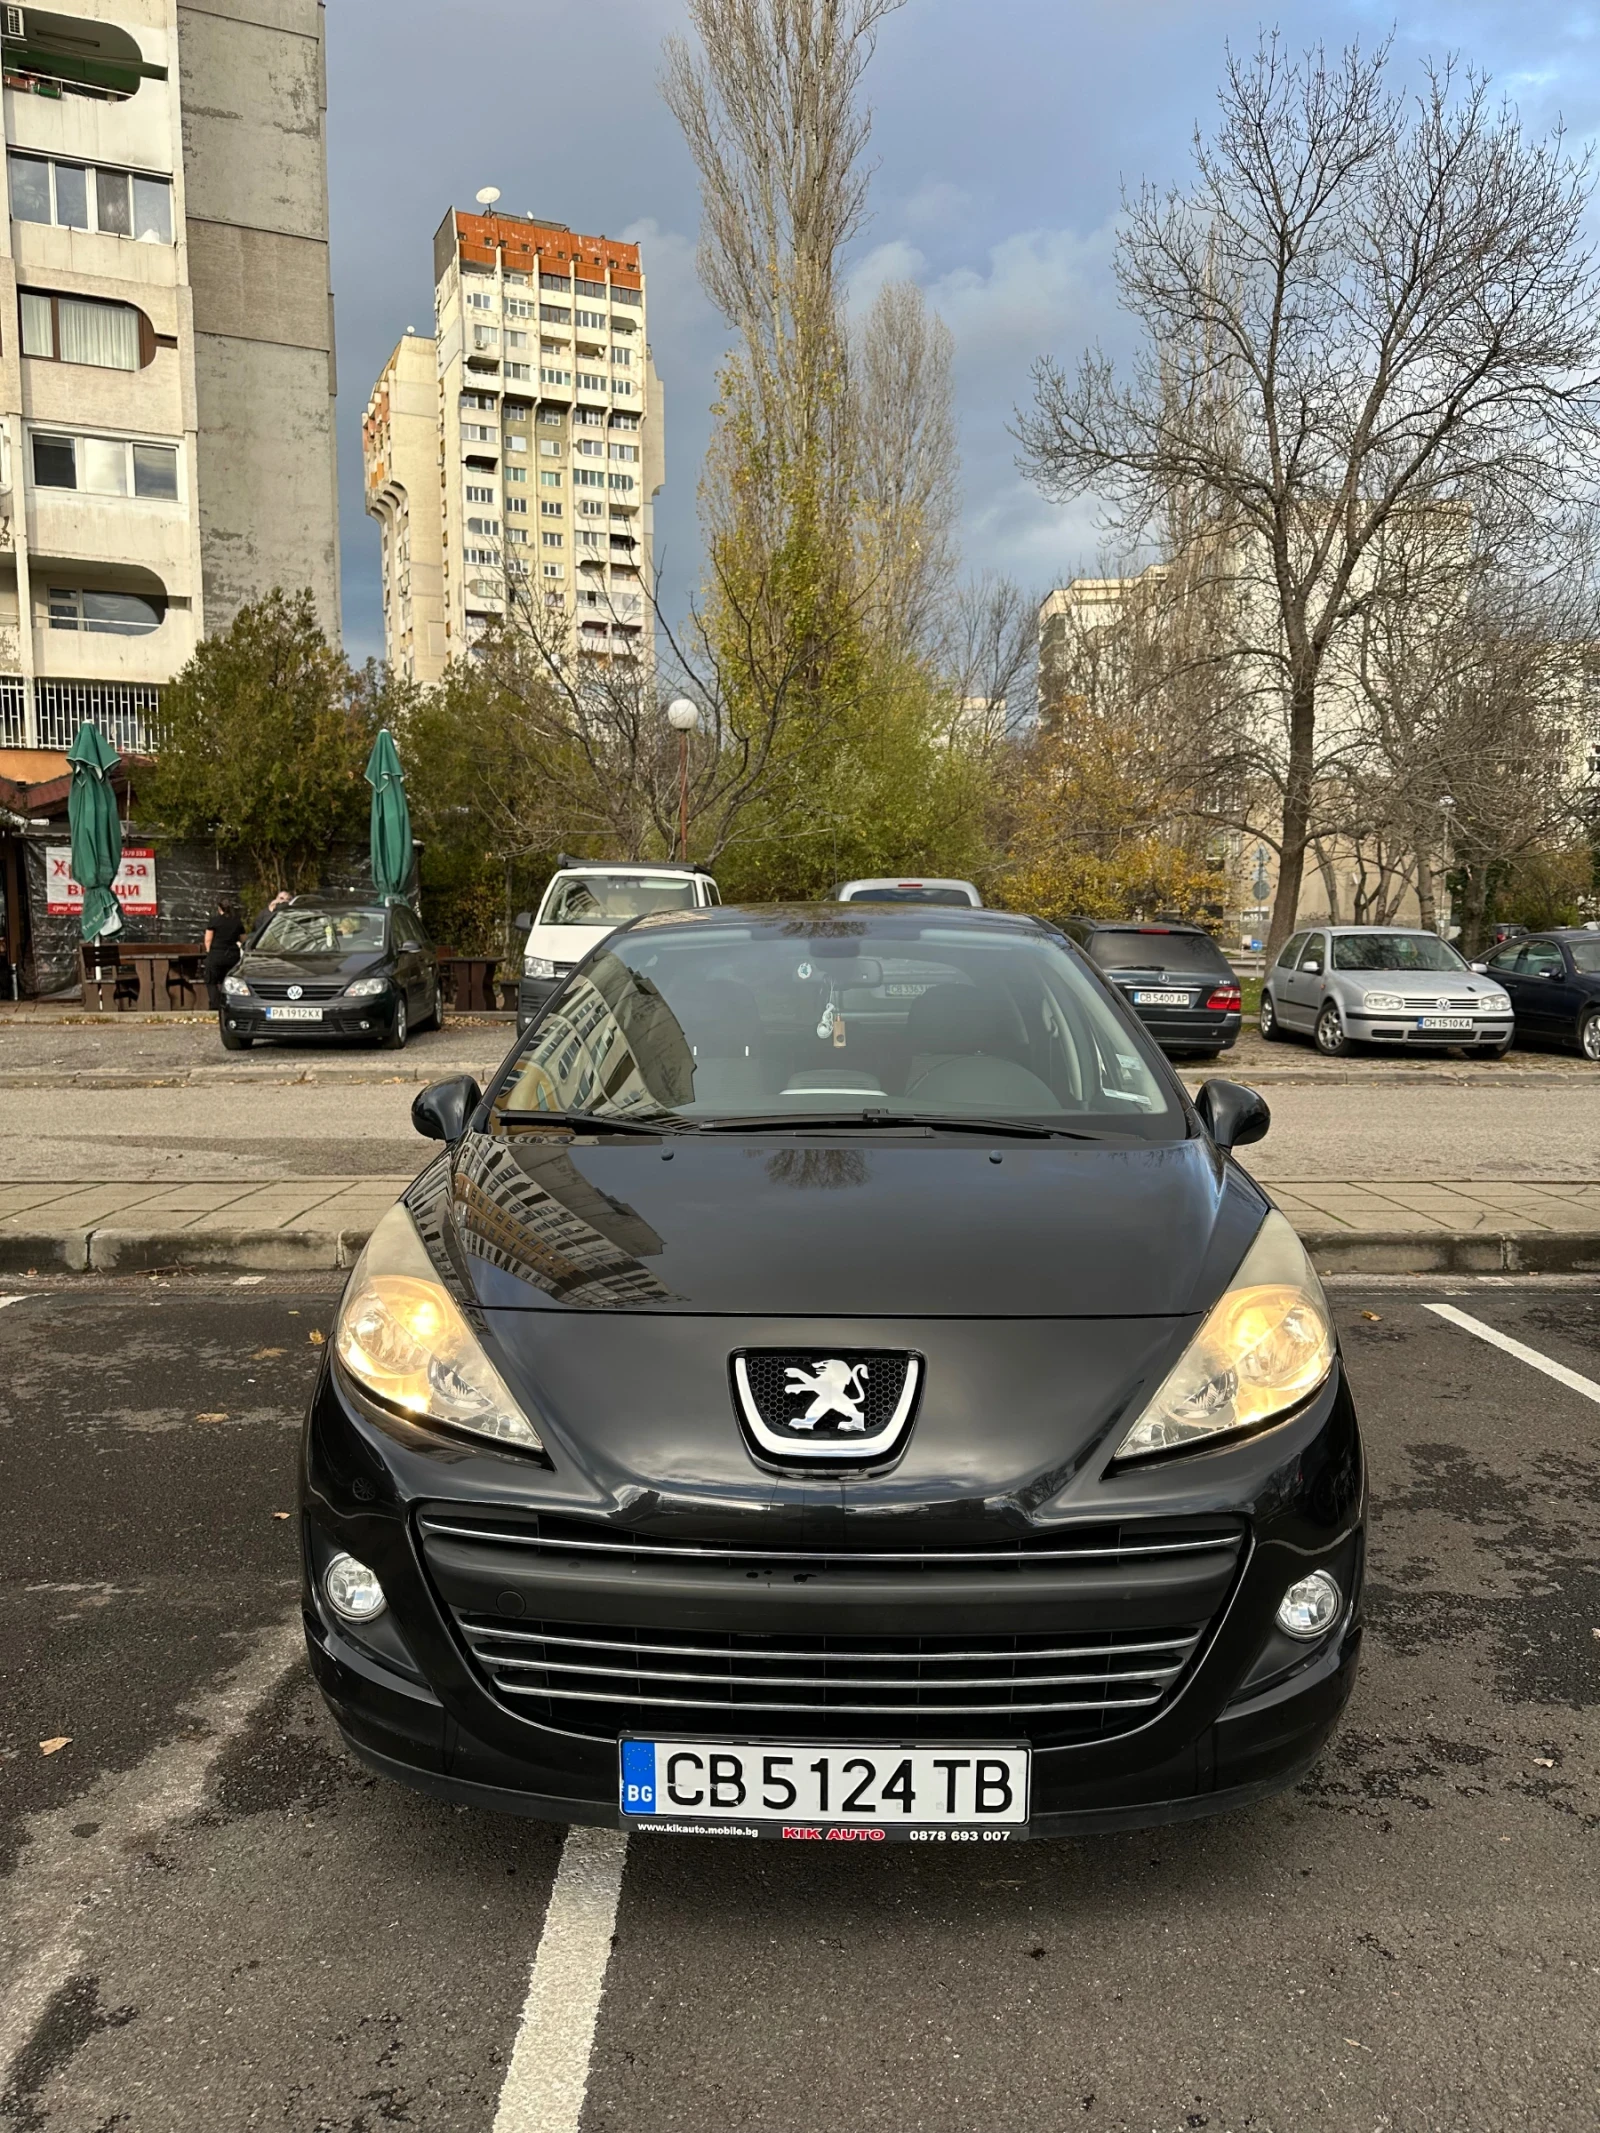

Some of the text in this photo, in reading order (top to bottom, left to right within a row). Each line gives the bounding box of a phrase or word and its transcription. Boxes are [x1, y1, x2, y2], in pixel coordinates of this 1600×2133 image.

[125, 864, 147, 876] за
[667, 1752, 1013, 1814] CB 5124 TB
[627, 1784, 653, 1803] BG
[637, 1823, 759, 1838] www.kikauto.mobile.bg
[782, 1826, 886, 1841] KIK AUTO
[909, 1830, 1011, 1842] 0878 693 007
